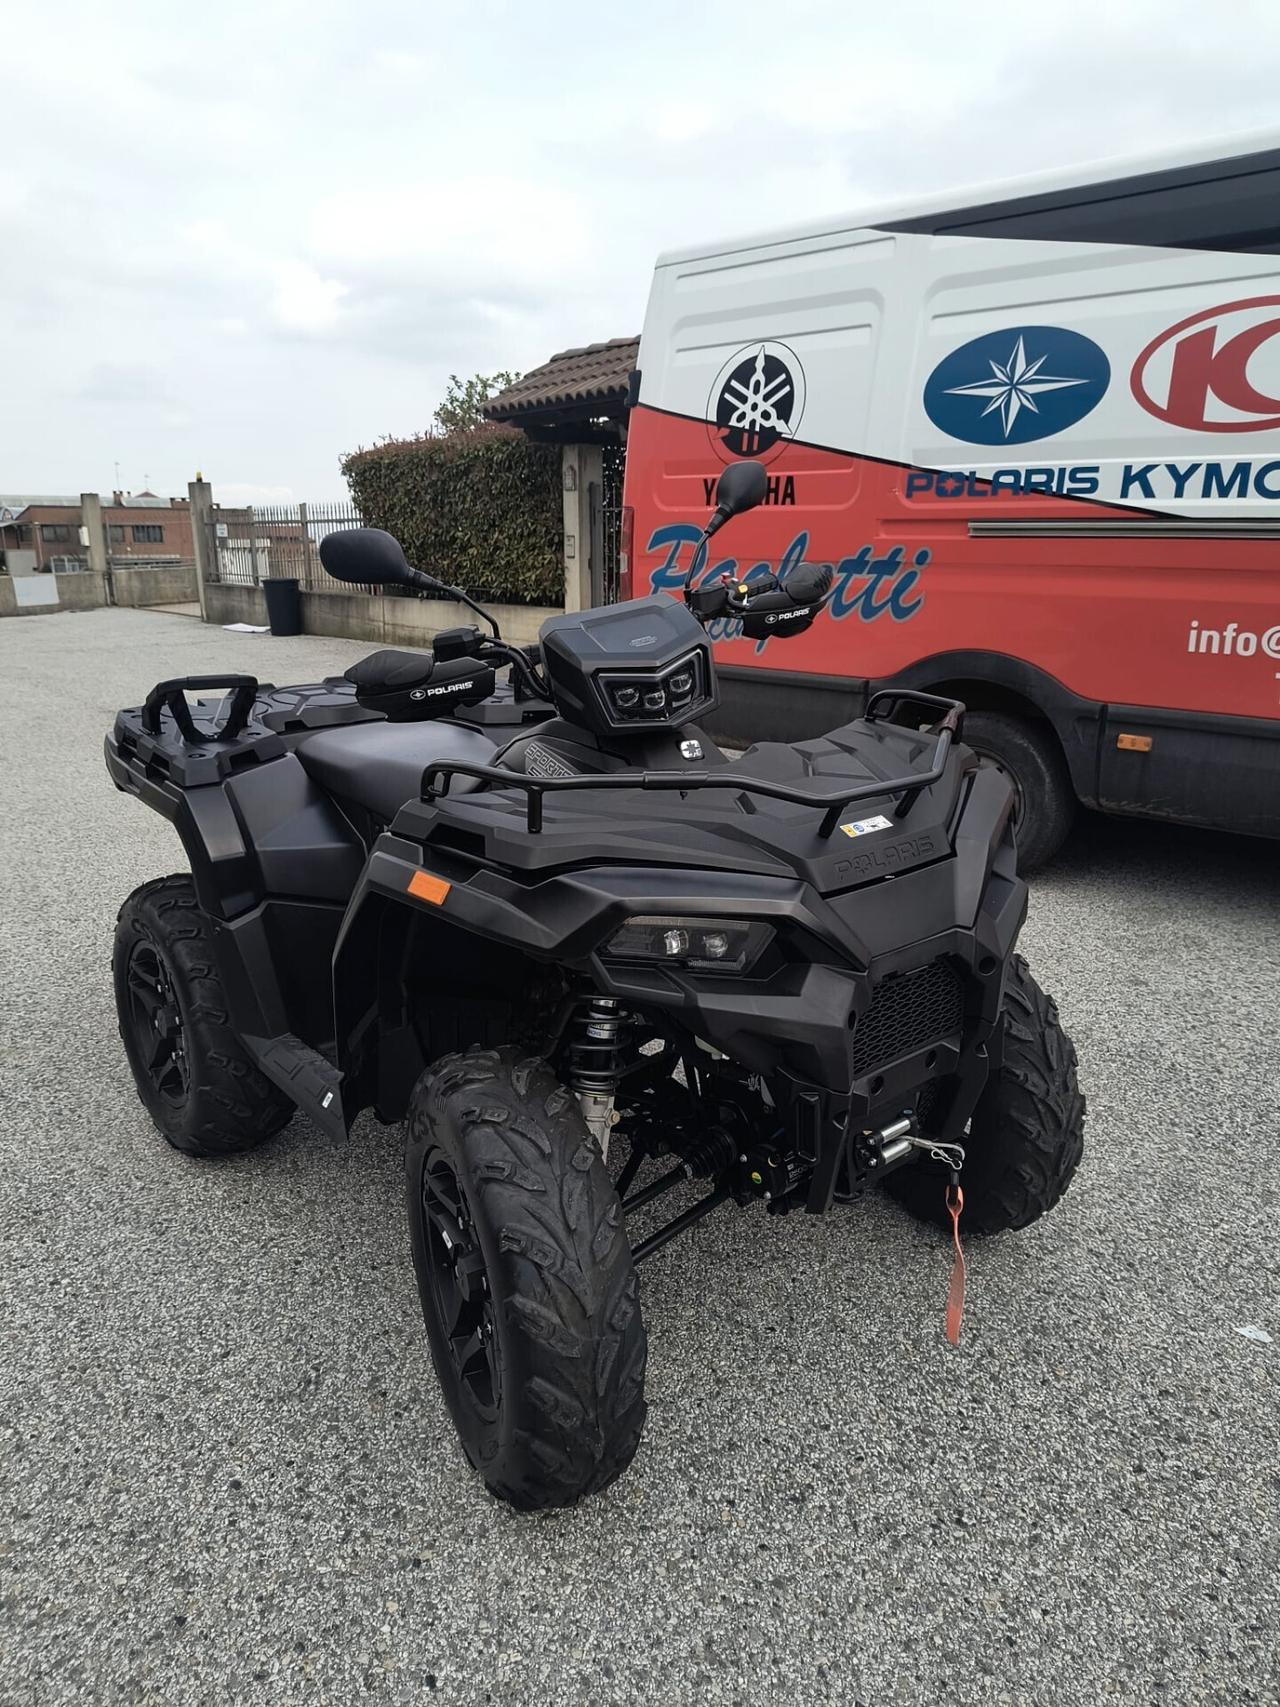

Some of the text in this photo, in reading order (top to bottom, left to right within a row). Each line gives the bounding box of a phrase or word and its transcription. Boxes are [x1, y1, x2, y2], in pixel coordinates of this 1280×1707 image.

[703, 475, 796, 507] YHA
[905, 465, 1100, 499] POLARIS
[779, 607, 810, 621] POLARIS
[427, 681, 473, 697] POLARIS
[834, 834, 935, 881] POLARIS
